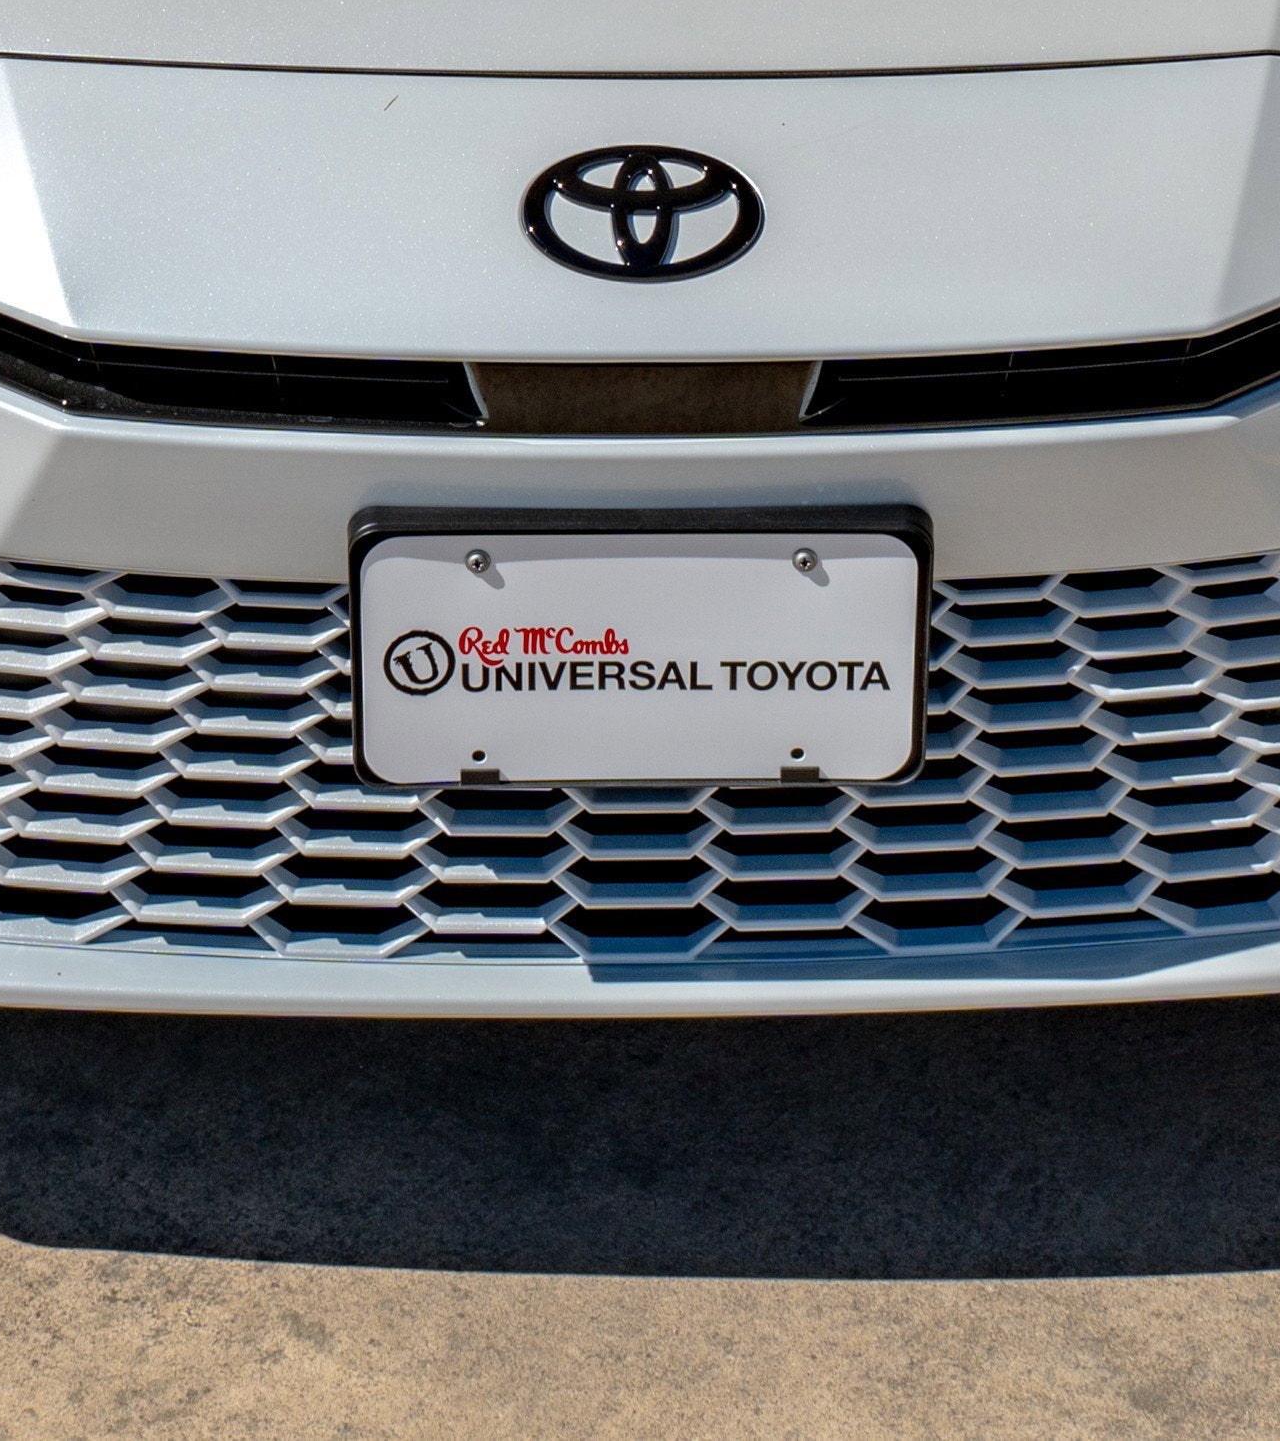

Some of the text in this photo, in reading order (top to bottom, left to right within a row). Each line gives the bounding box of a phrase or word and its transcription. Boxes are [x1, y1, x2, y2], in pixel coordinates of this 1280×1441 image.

[459, 627, 630, 666] Red McCombs
[461, 660, 891, 693] UNIVERSAL TOYOTA
